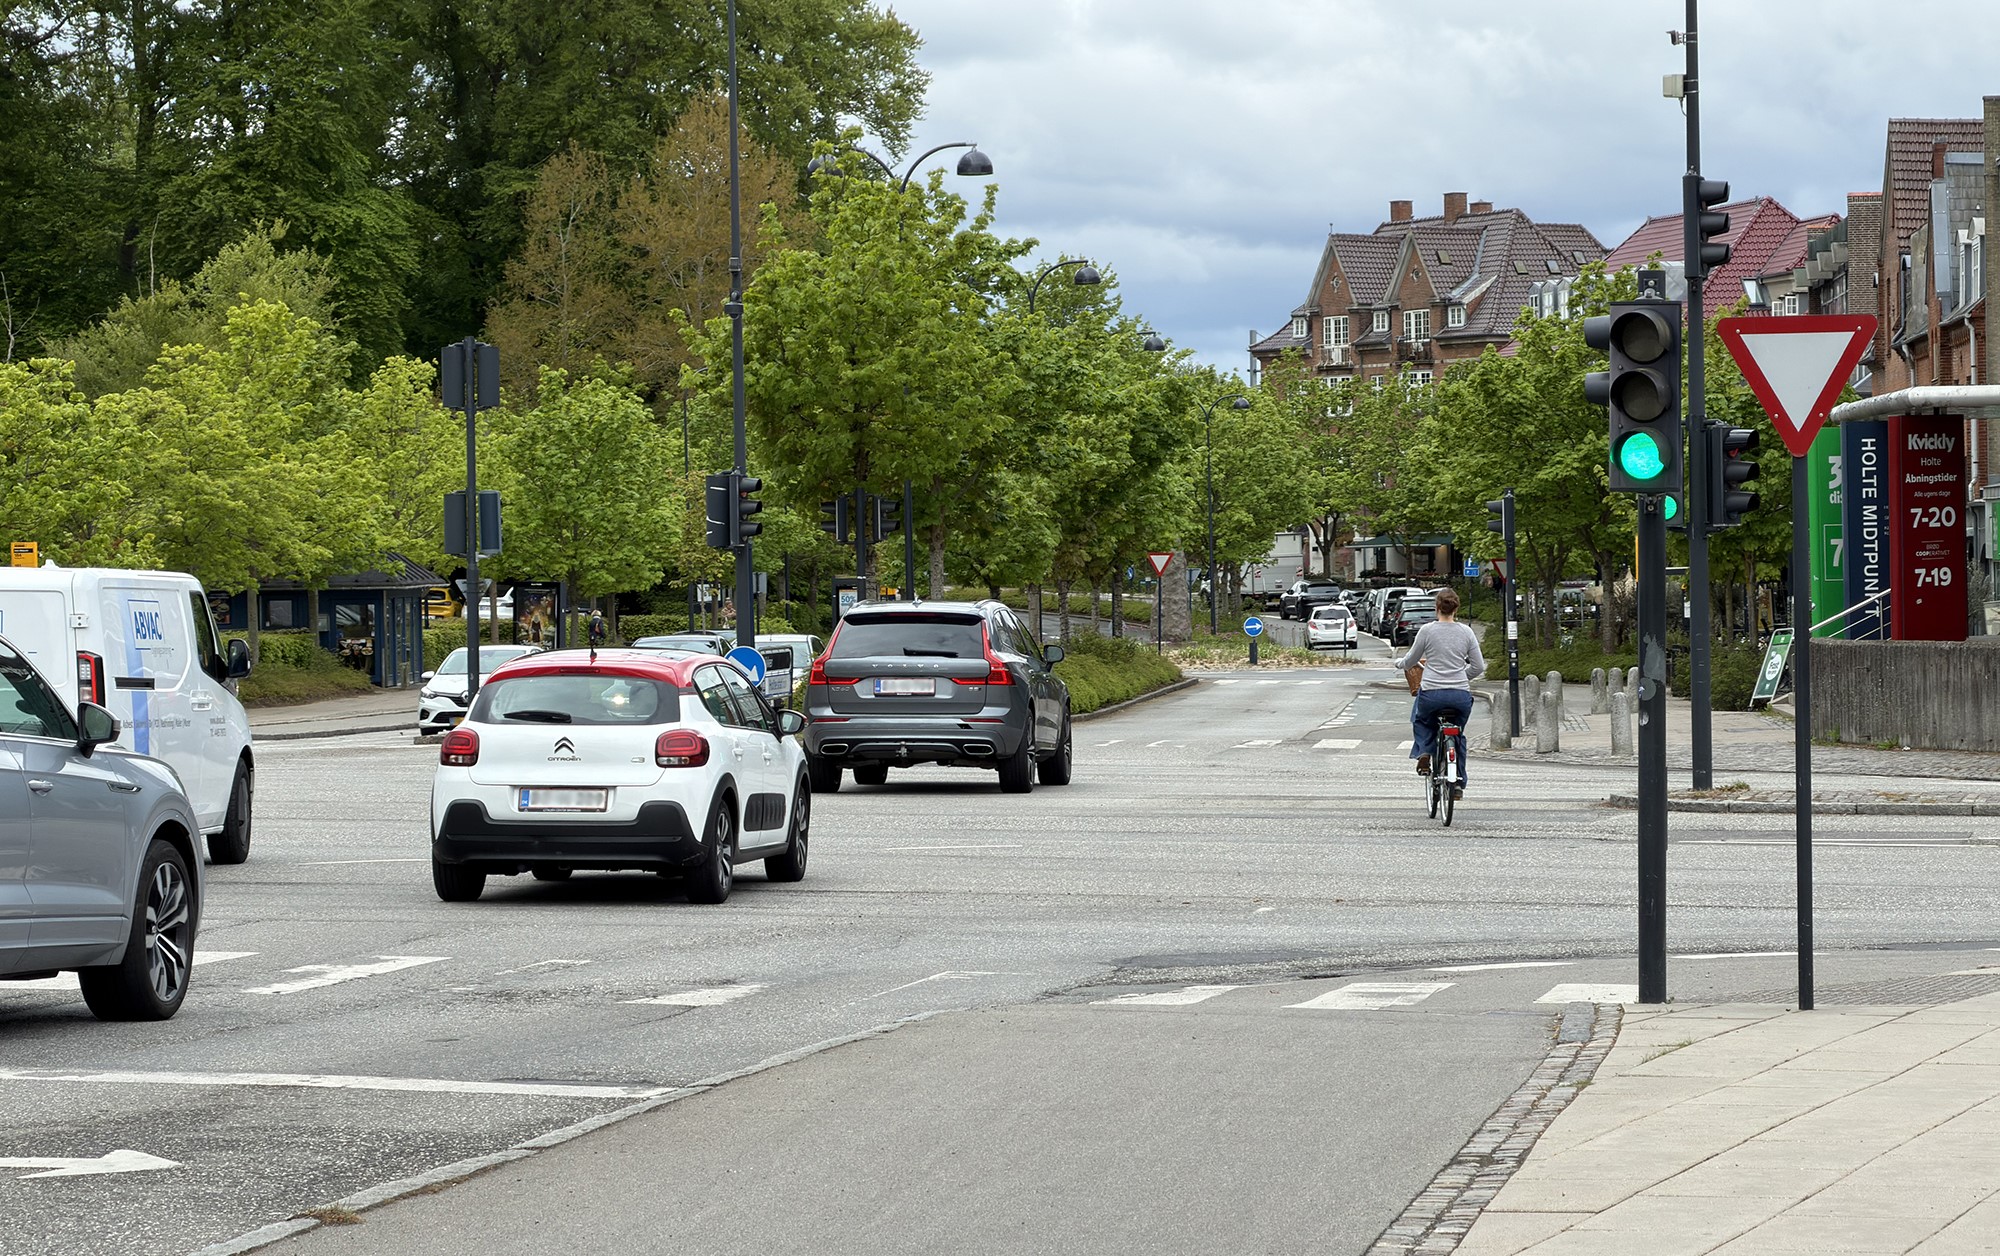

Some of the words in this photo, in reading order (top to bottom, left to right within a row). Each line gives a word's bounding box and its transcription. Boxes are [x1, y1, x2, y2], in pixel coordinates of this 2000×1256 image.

[1907, 433, 1956, 453] Kvickly
[1861, 438, 1877, 499] HOLTE
[1920, 457, 1942, 466] Holte
[1905, 473, 1957, 484] Åbningstider
[1910, 506, 1956, 528] 7-20
[1914, 566, 1952, 587] 7-19
[133, 611, 163, 640] ABVAC
